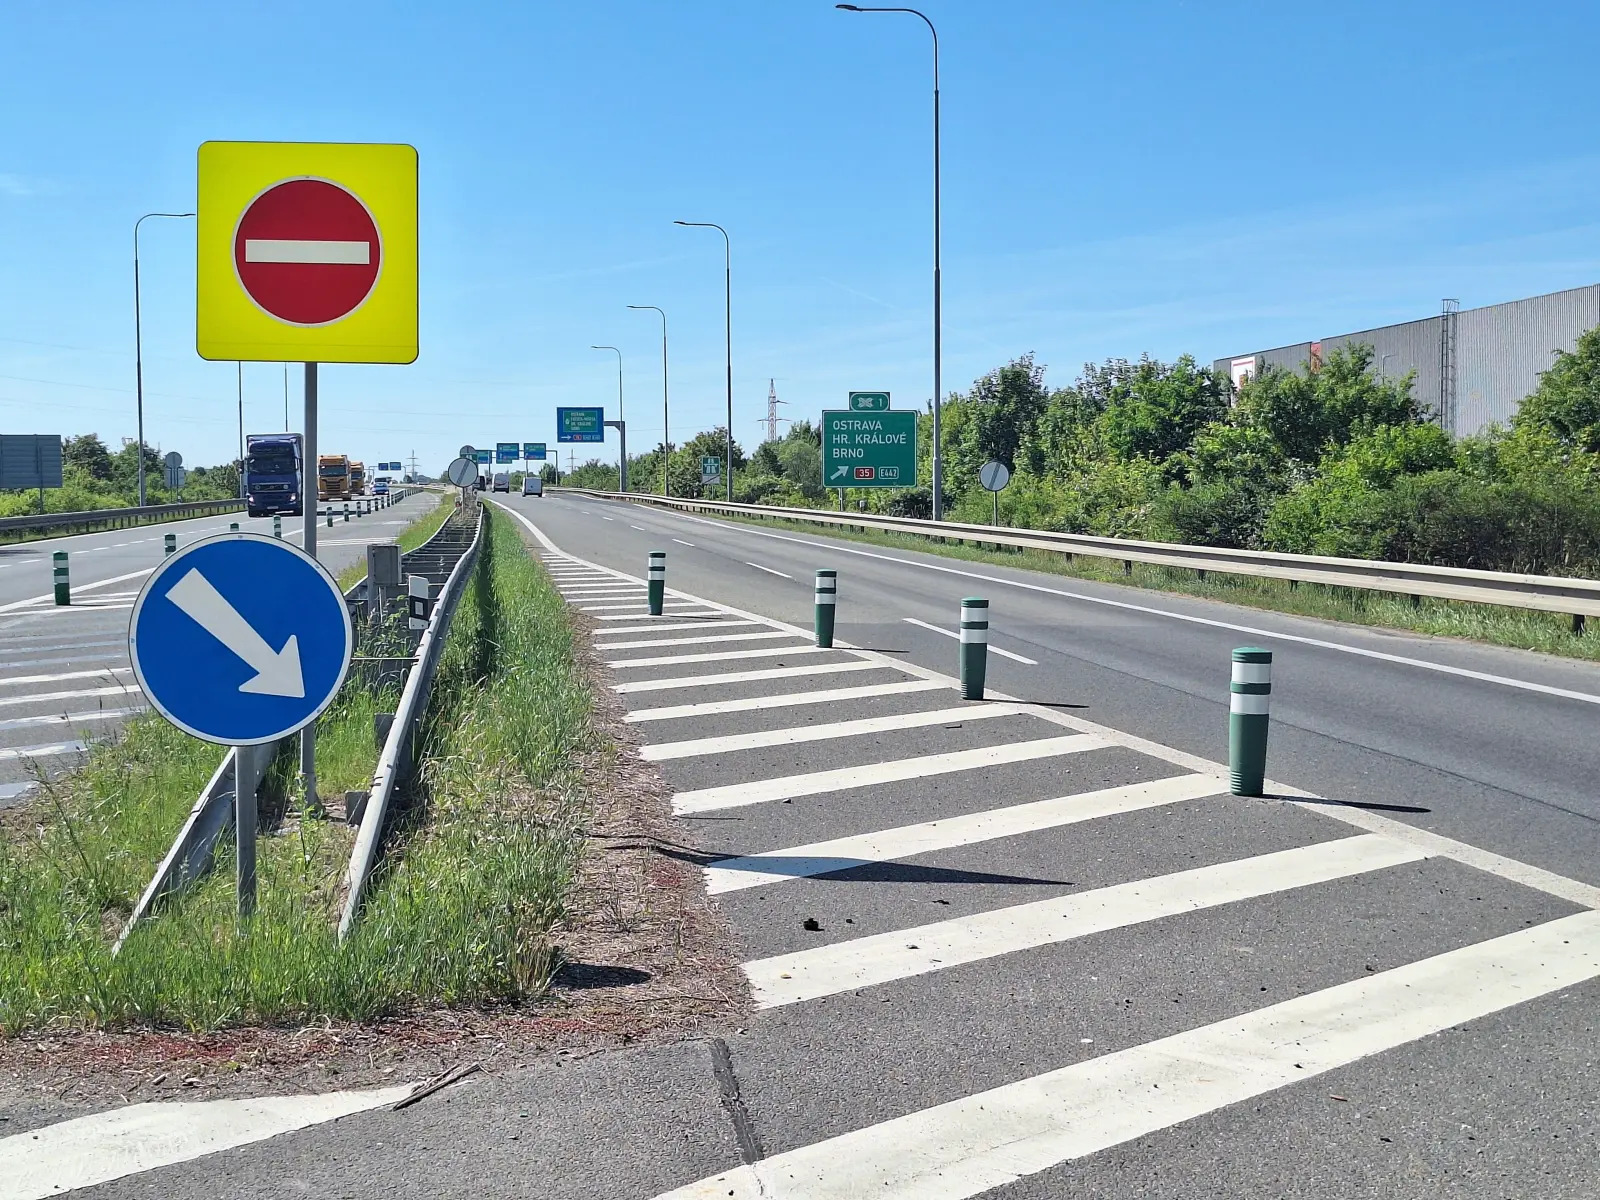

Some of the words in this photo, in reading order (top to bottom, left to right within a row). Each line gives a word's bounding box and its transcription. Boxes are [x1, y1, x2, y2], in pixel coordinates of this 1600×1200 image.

[832, 420, 883, 430] OSTRAVA
[832, 434, 851, 444] HR.
[855, 432, 907, 444] KRÁLOVÉ
[832, 448, 864, 458] BRNO
[859, 468, 870, 477] 35
[880, 468, 897, 477] E442
